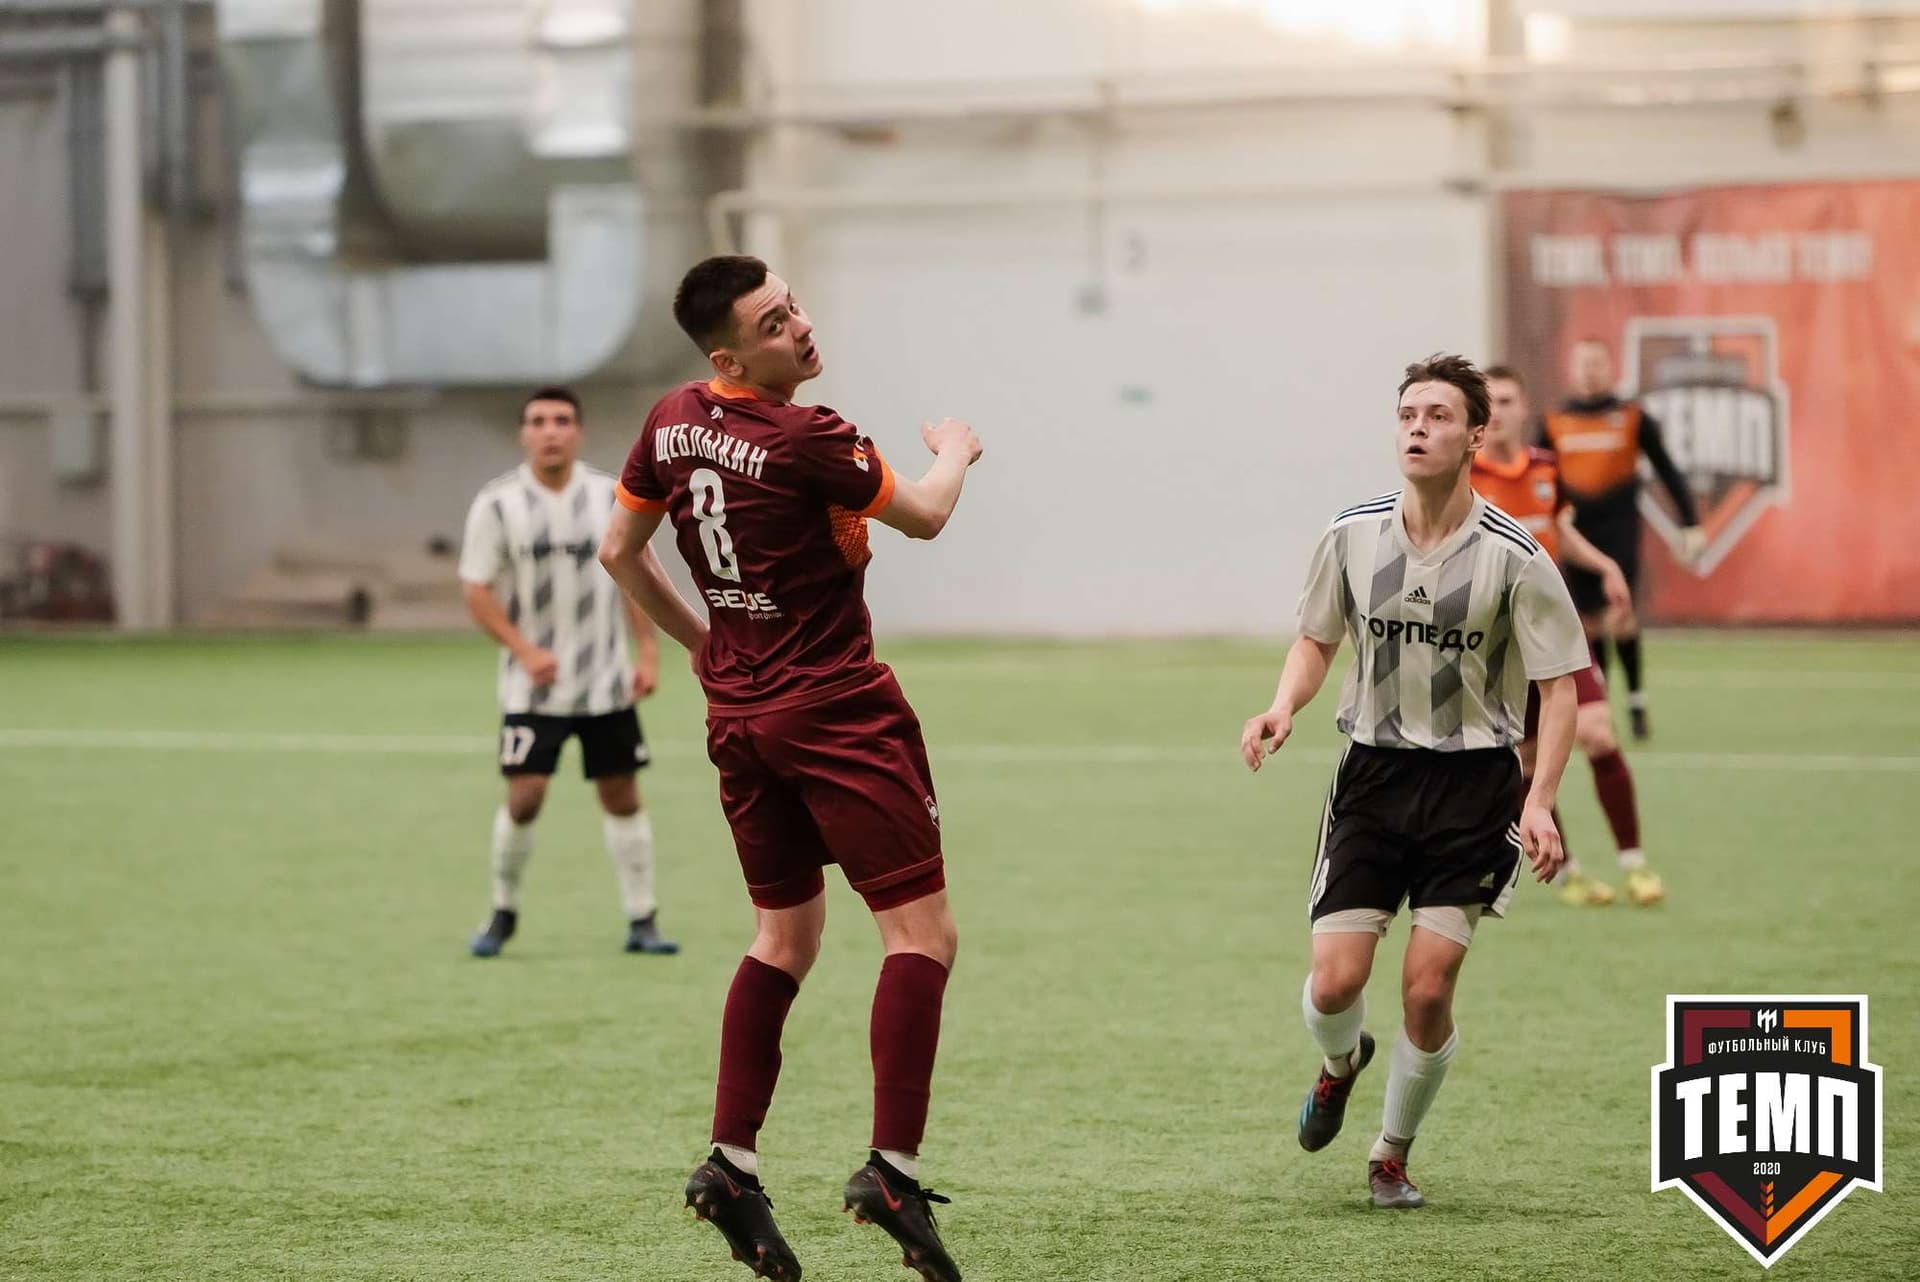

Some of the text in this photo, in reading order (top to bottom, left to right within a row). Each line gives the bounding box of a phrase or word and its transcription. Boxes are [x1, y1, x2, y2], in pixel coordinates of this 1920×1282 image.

[655, 423, 768, 480] ЩЕБЛЫКИН
[688, 468, 742, 583] 8
[1404, 596, 1431, 606] adidas
[1360, 613, 1485, 653] ОРПЕДО
